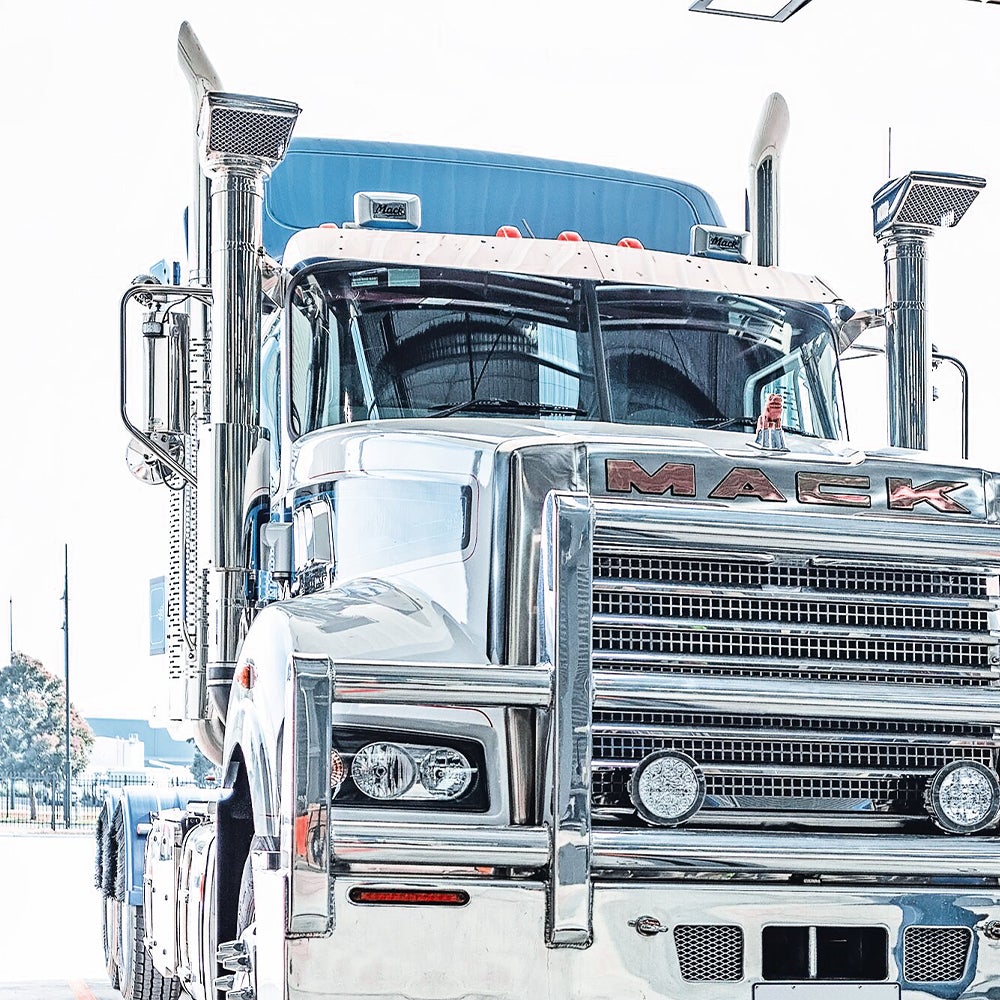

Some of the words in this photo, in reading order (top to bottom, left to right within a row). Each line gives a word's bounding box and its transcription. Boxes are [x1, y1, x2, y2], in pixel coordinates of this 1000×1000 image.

[375, 203, 406, 216] Mack
[711, 236, 740, 250] Mack
[605, 458, 972, 514] MACK
